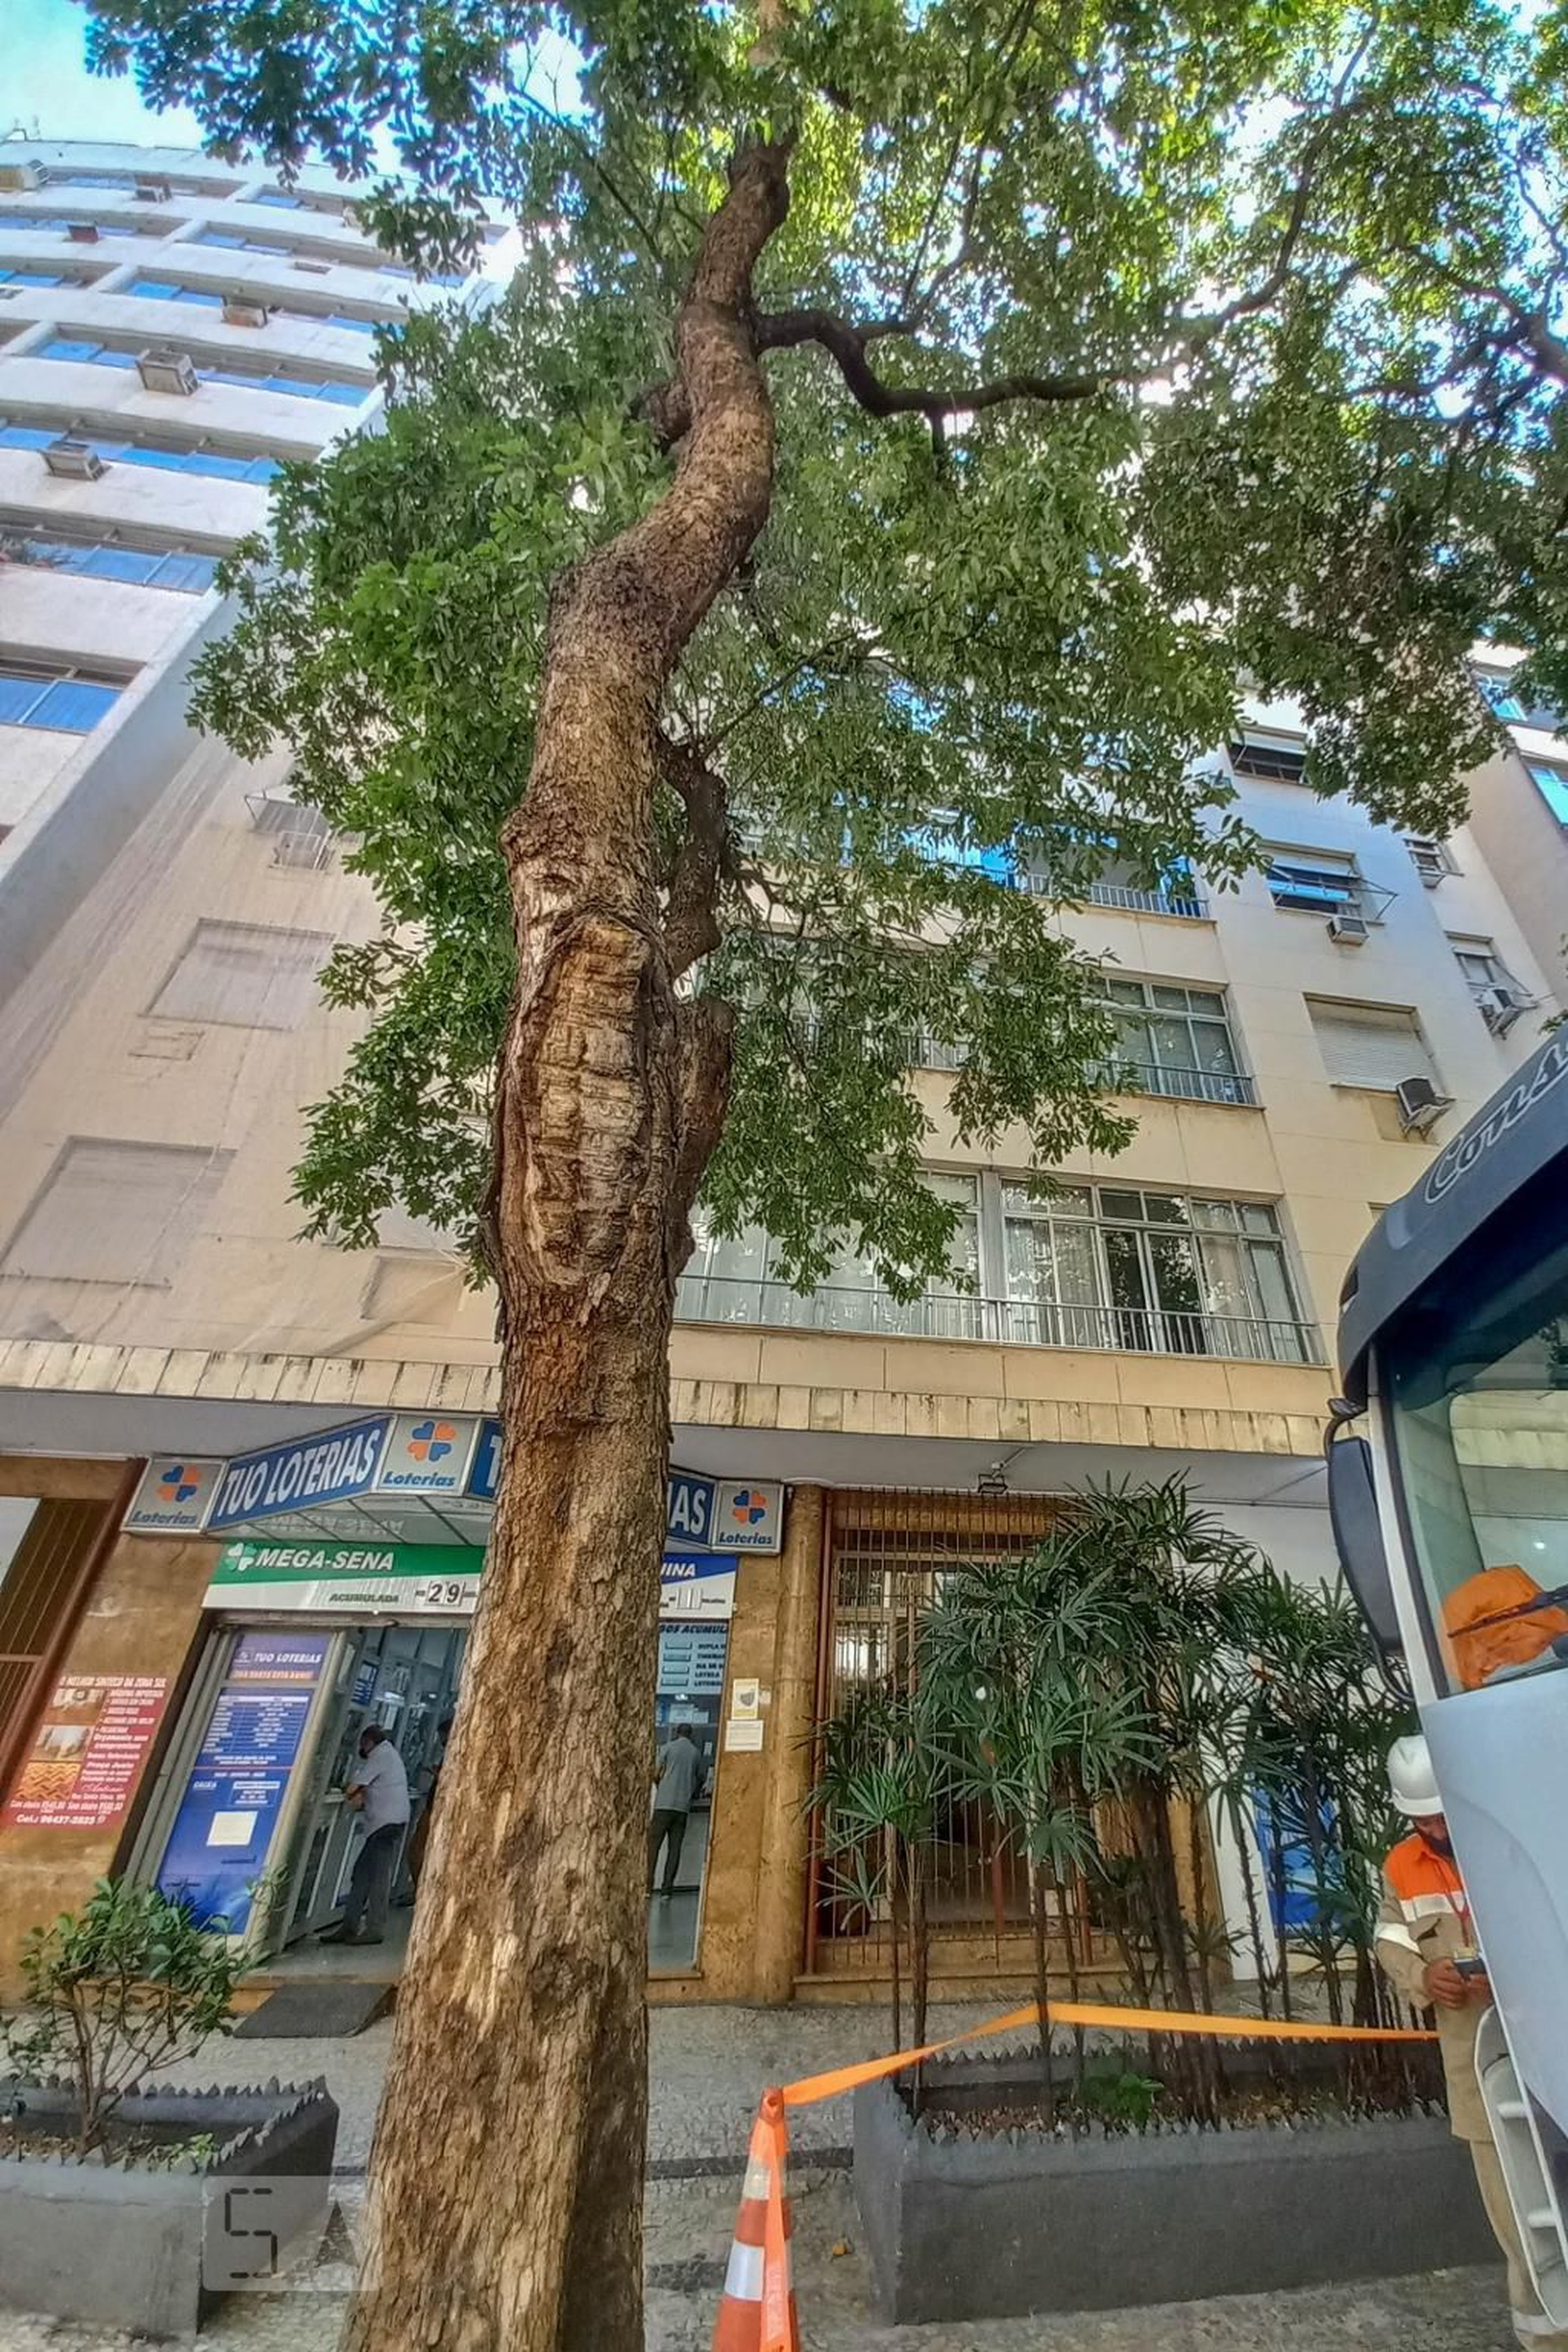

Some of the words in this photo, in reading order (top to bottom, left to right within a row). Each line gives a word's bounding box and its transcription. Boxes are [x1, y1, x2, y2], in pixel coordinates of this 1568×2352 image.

[217, 1461, 268, 1517] TUO
[263, 1429, 380, 1506] LOTERIAS
[383, 1471, 455, 1486] Loterias
[131, 1510, 198, 1525] Loterias
[718, 1532, 773, 1544] Loterias
[256, 1548, 394, 1570] MEGA-SENA
[254, 1653, 274, 1663] TUO
[276, 1653, 322, 1664] LOTERIAS
